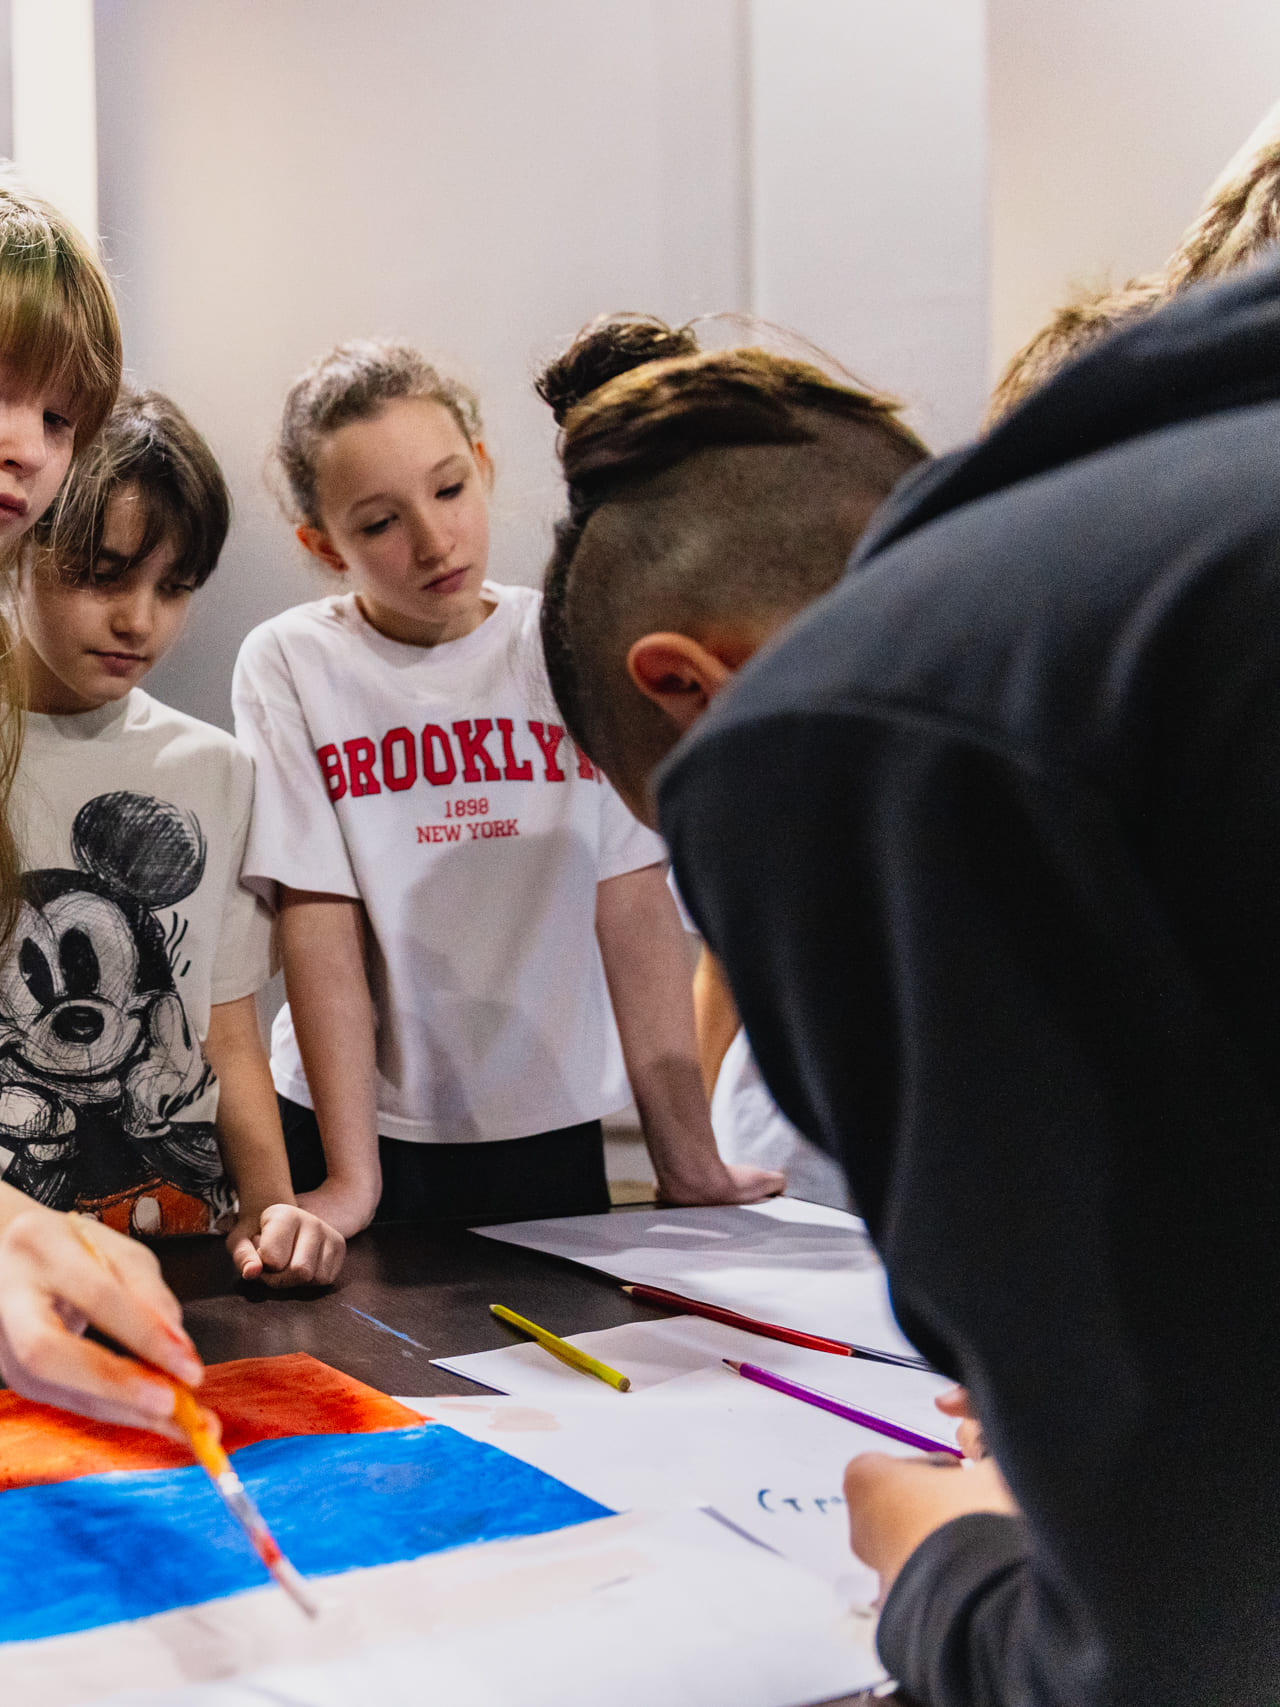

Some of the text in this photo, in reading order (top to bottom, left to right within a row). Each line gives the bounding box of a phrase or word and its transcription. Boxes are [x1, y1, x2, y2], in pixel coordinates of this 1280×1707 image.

[445, 798, 489, 818] 1898
[416, 819, 520, 844] NEW YORK
